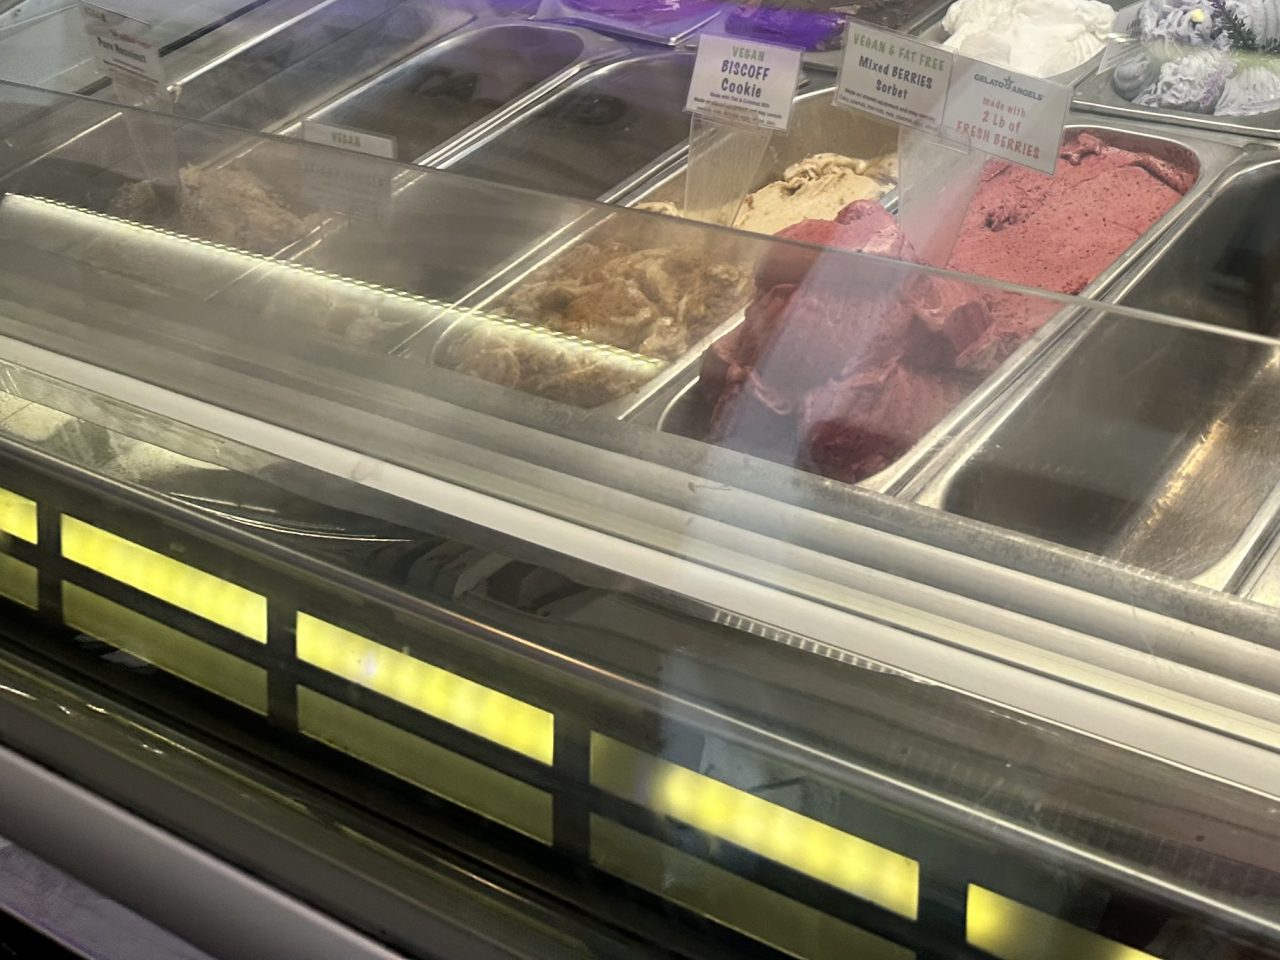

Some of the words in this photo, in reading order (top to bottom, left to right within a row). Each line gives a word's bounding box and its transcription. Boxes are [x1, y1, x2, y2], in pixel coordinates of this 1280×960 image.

[732, 46, 765, 62] VEGAN
[853, 33, 885, 54] VEGAN
[899, 47, 917, 62] FAT
[919, 54, 945, 71] FREE
[721, 60, 770, 80] BISCOFF
[859, 55, 890, 75] Mixed
[892, 66, 933, 89] BERRIES
[721, 77, 762, 98] Cookie
[876, 79, 908, 100] Sorbet
[974, 74, 1004, 88] GELATO
[1011, 86, 1043, 101] ANGELS
[982, 97, 1005, 111] made
[1007, 105, 1026, 118] with
[982, 110, 990, 123] 2
[993, 113, 1005, 128] Lb
[1009, 122, 1022, 133] of
[955, 121, 990, 142] FRESH
[993, 133, 1040, 159] BERRIES
